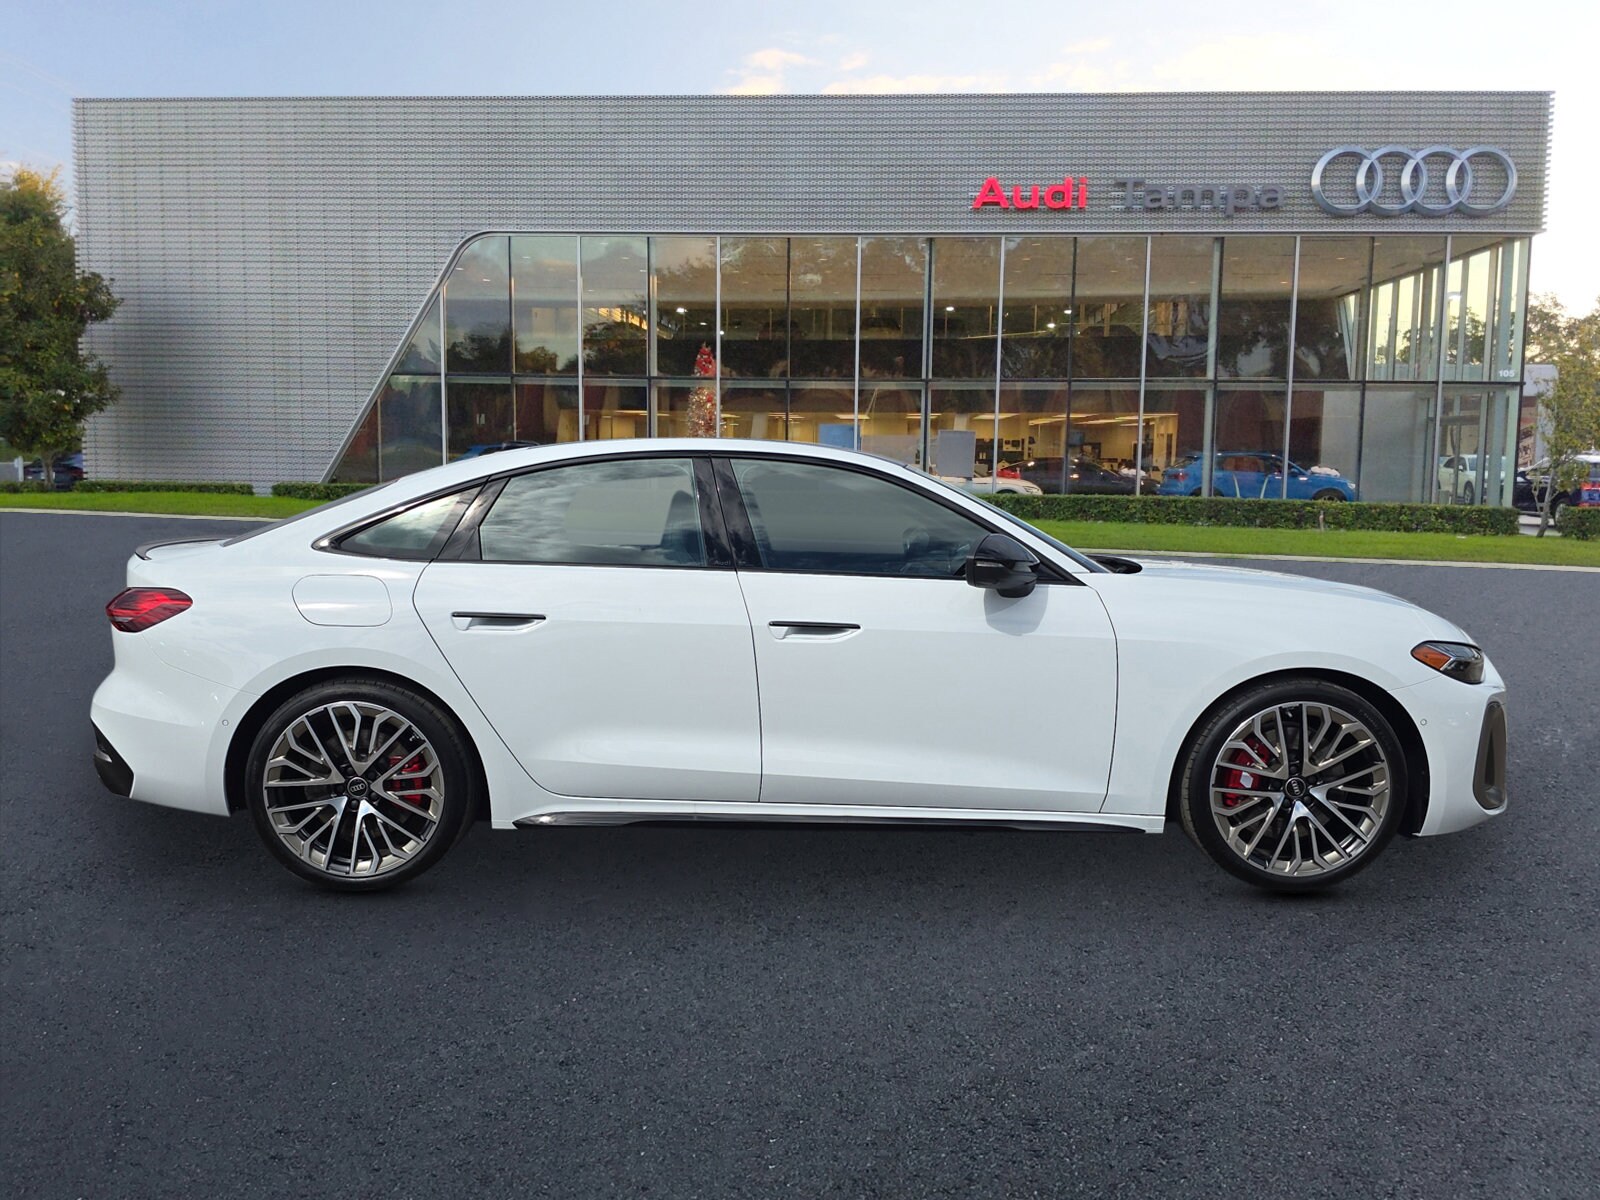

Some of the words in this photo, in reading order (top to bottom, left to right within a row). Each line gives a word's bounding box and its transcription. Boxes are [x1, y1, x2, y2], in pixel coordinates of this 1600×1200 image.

[972, 177, 1088, 209] Audi
[1116, 178, 1285, 217] Tampa
[1499, 369, 1515, 378] 105
